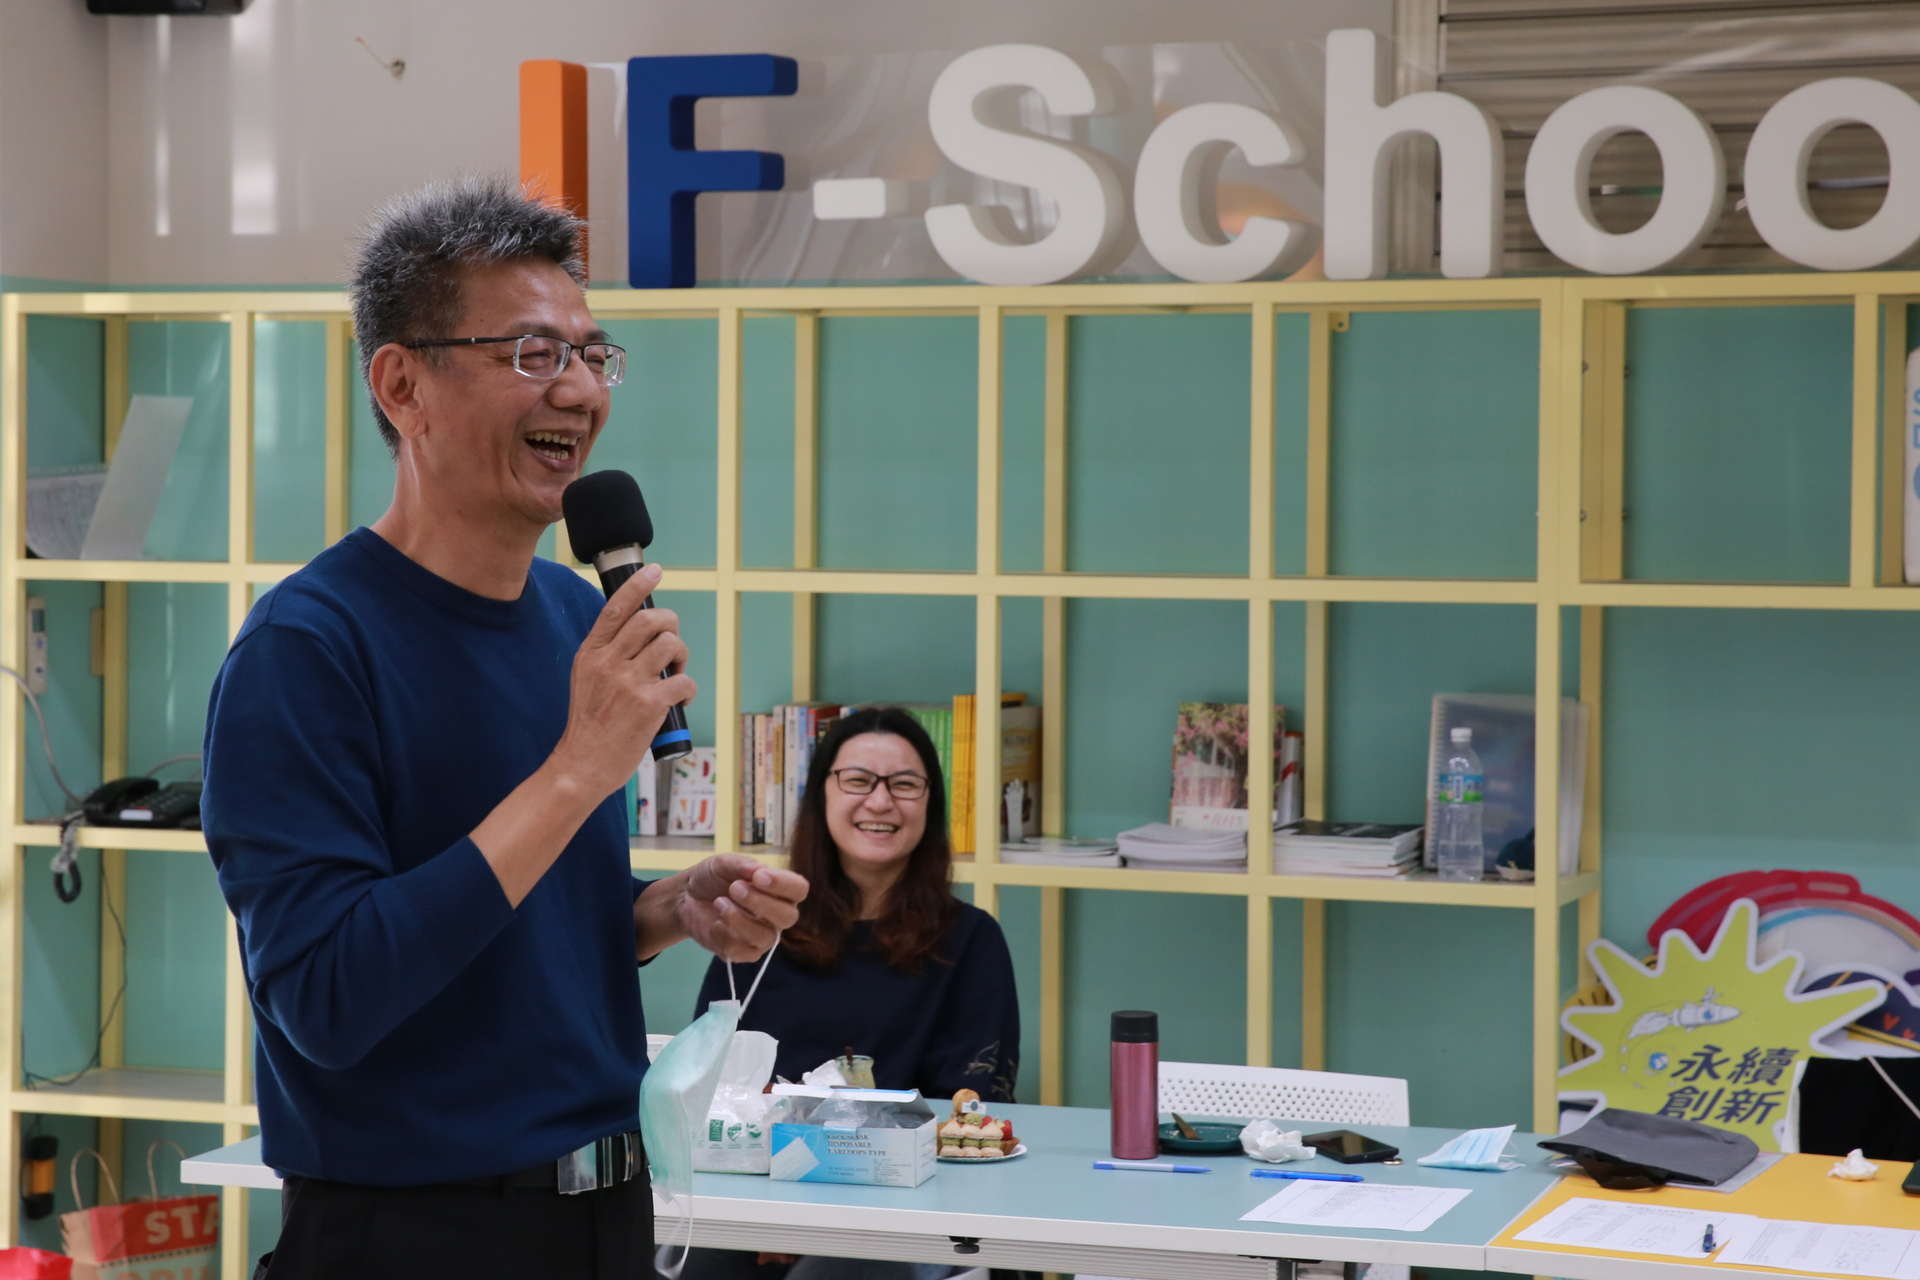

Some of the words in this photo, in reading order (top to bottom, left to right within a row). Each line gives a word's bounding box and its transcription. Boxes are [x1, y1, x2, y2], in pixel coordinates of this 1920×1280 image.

[1670, 1044, 1799, 1085] 永續
[1656, 1086, 1785, 1125] 創新
[828, 1140, 872, 1148] DISPOSABLE
[828, 1148, 867, 1156] EARLOOPS
[869, 1149, 888, 1157] TYPE
